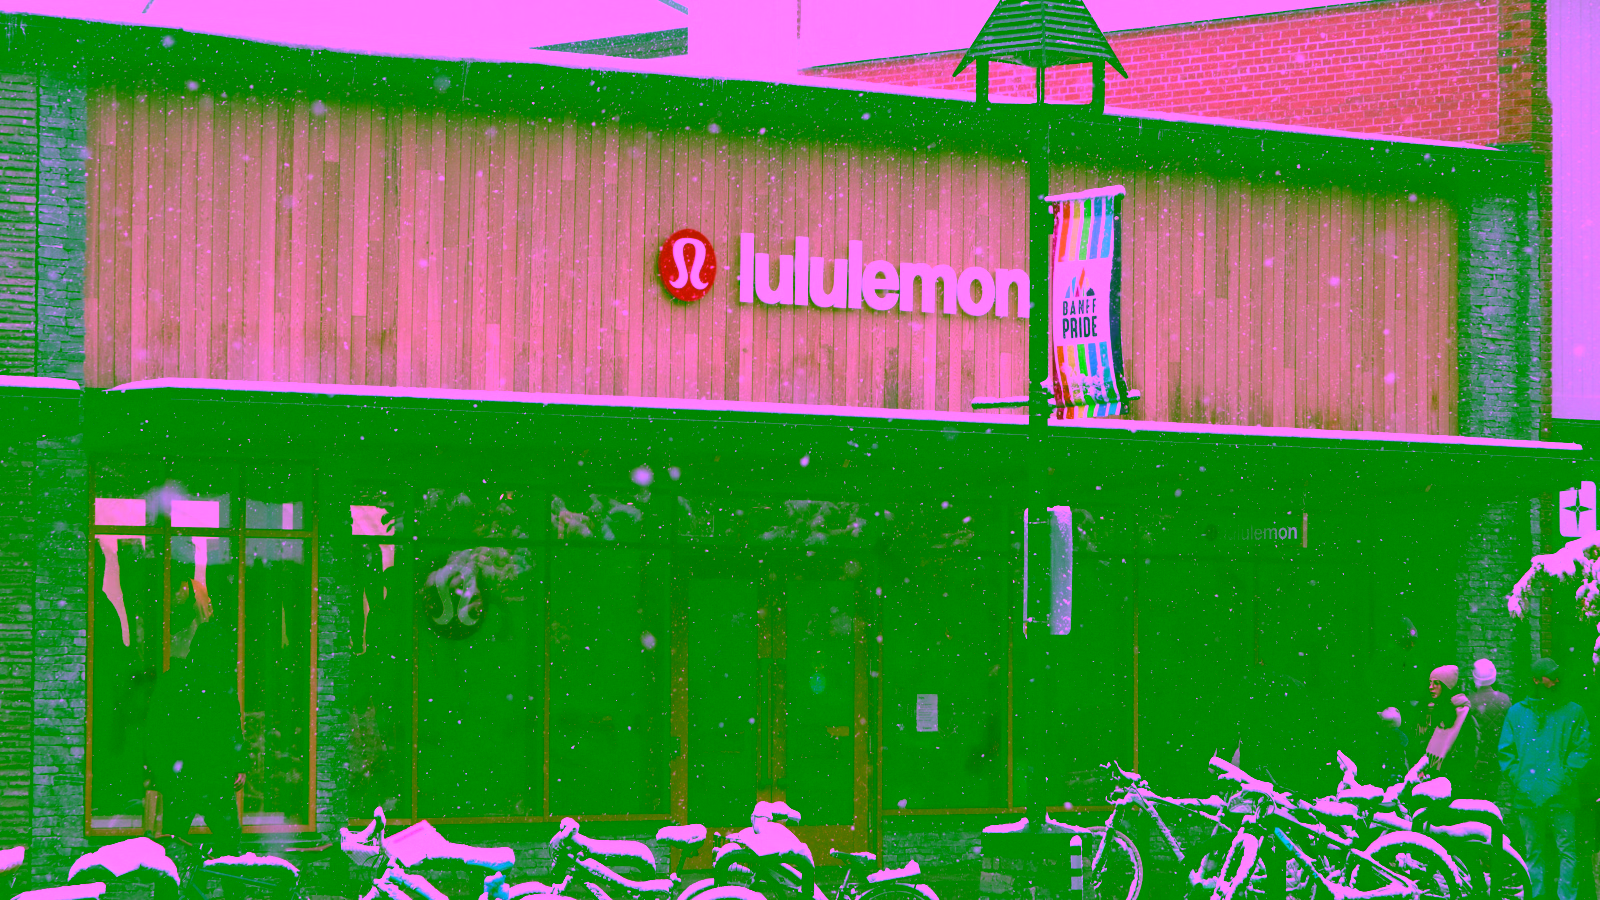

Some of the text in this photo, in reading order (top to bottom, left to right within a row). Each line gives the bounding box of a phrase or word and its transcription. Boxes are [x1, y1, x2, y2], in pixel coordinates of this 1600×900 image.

[740, 233, 1030, 318] lululemon
[1063, 298, 1097, 316] BANFF
[1062, 315, 1097, 339] PRIDE
